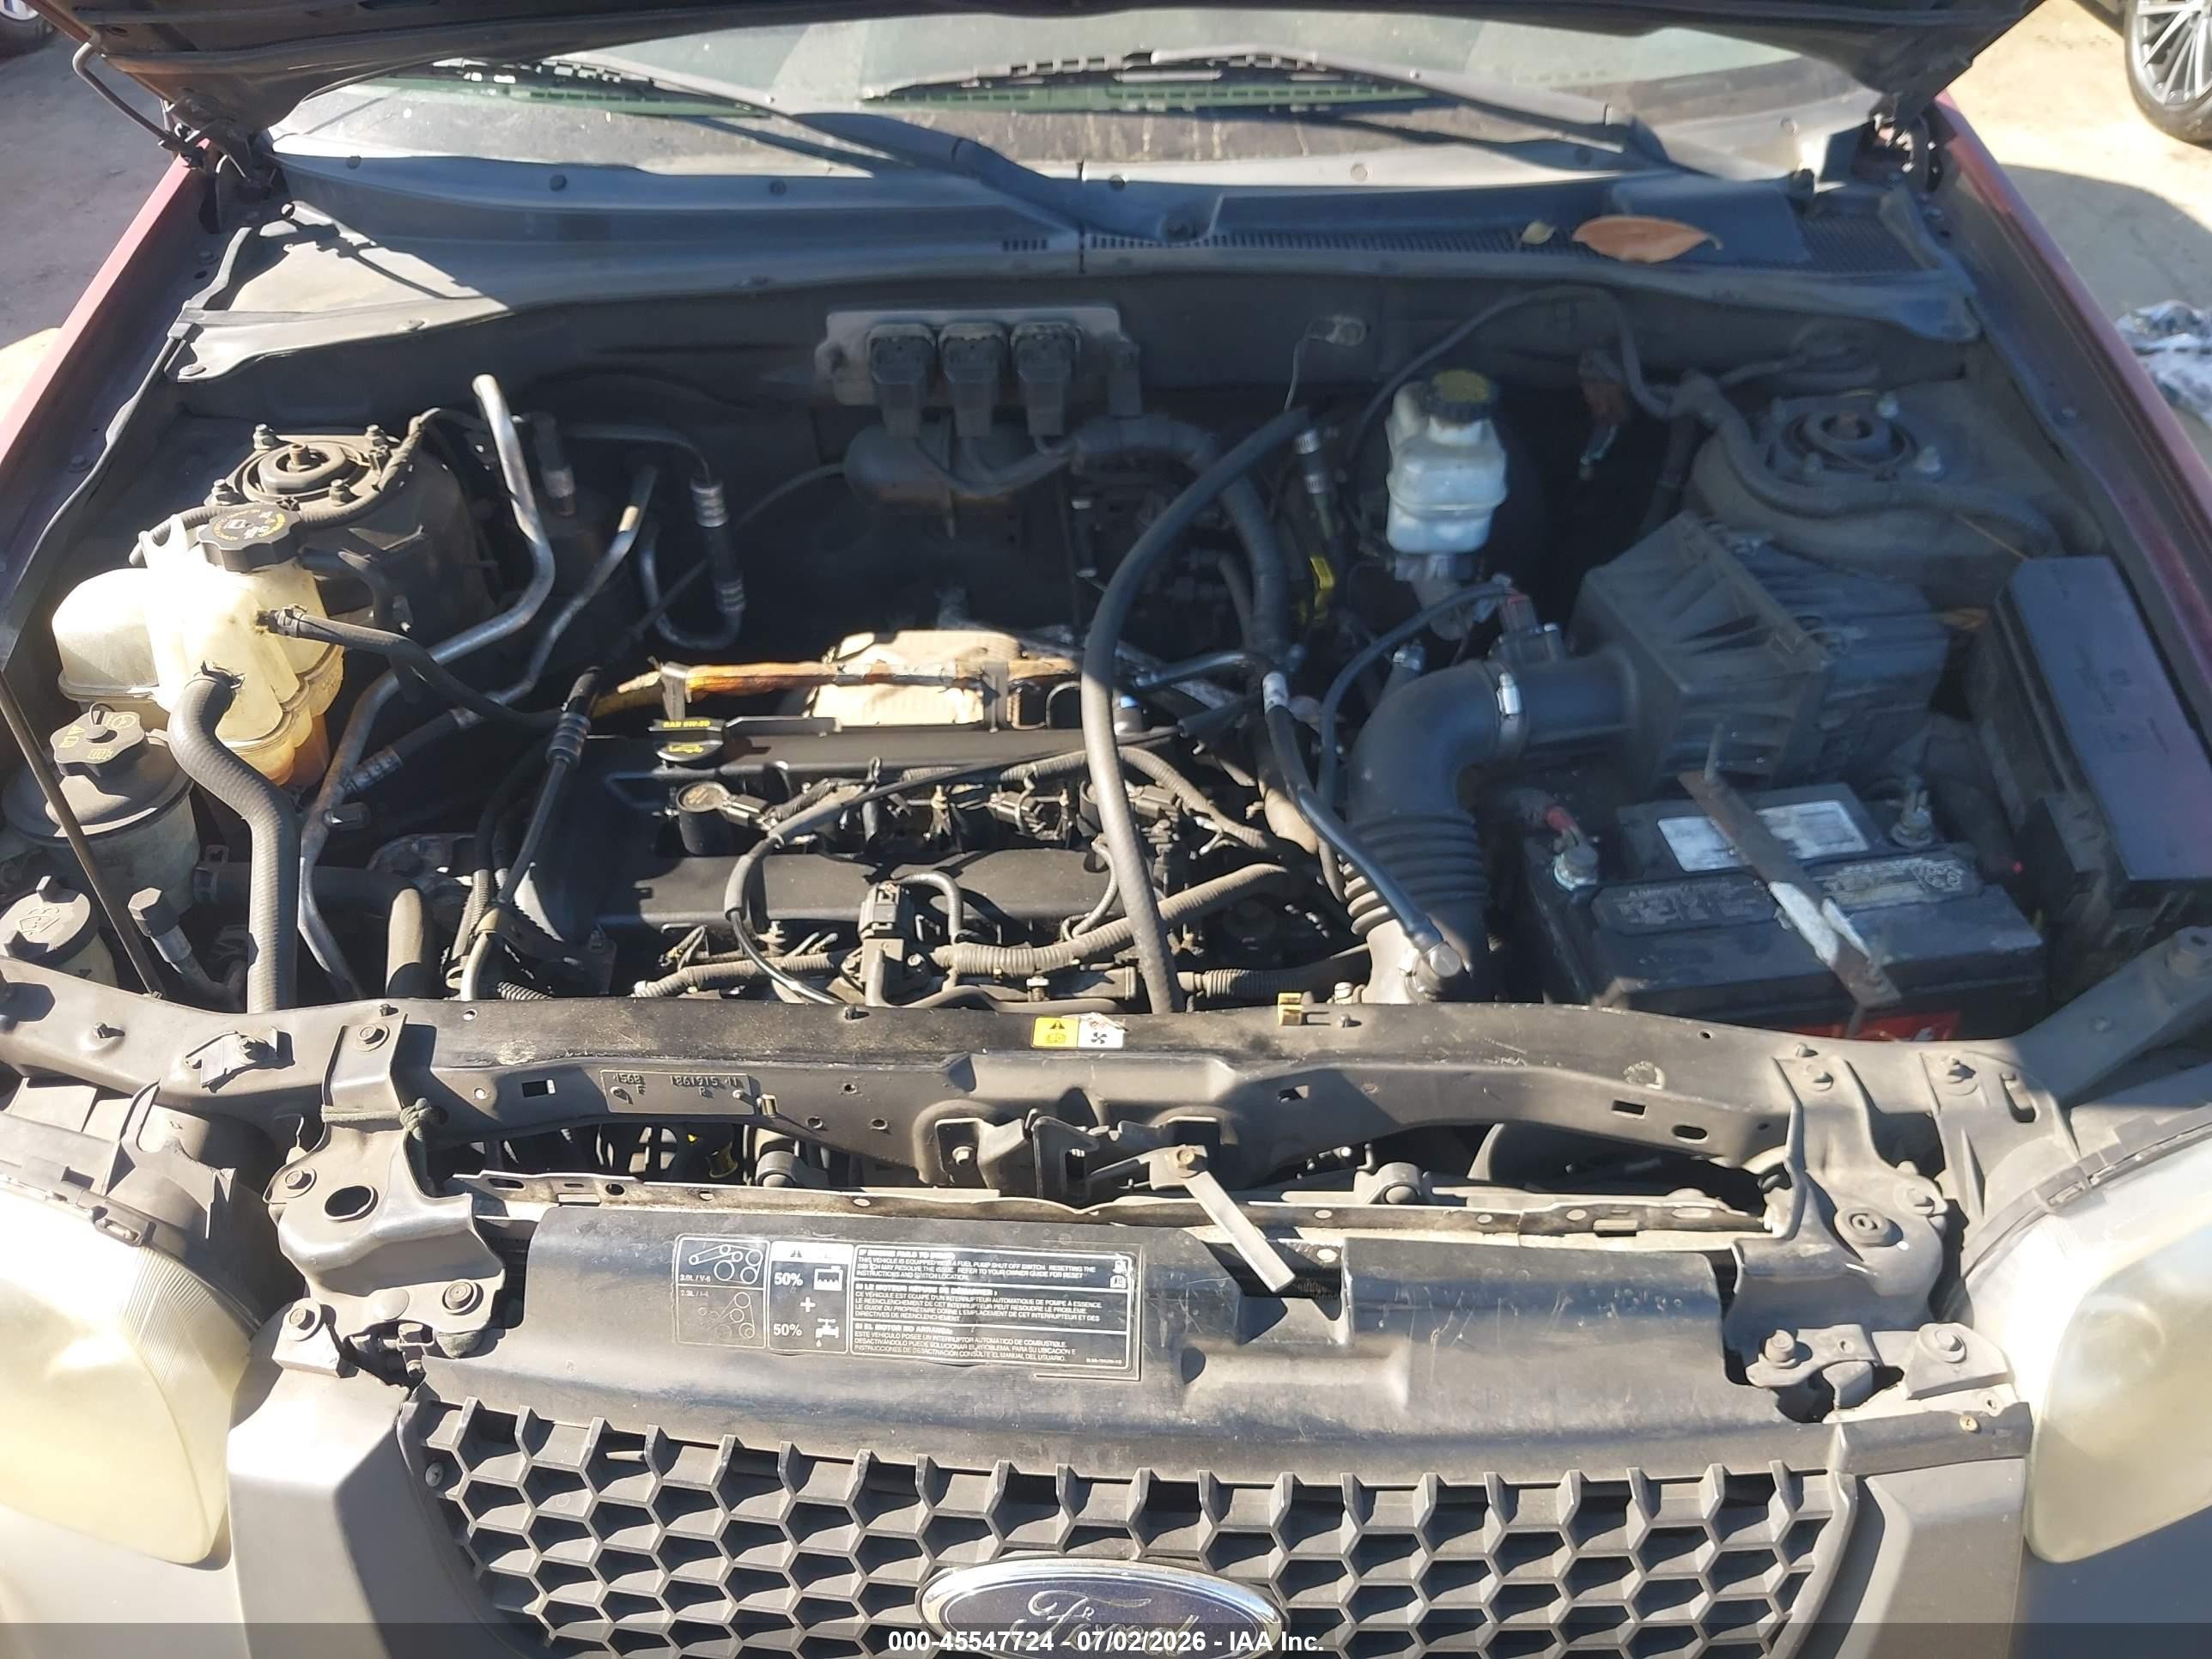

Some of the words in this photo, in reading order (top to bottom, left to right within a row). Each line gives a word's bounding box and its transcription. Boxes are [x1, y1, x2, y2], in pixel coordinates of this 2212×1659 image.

[774, 1272, 804, 1286] 50%
[773, 1323, 803, 1337] 50%
[1010, 1590, 1200, 1657] Ford
